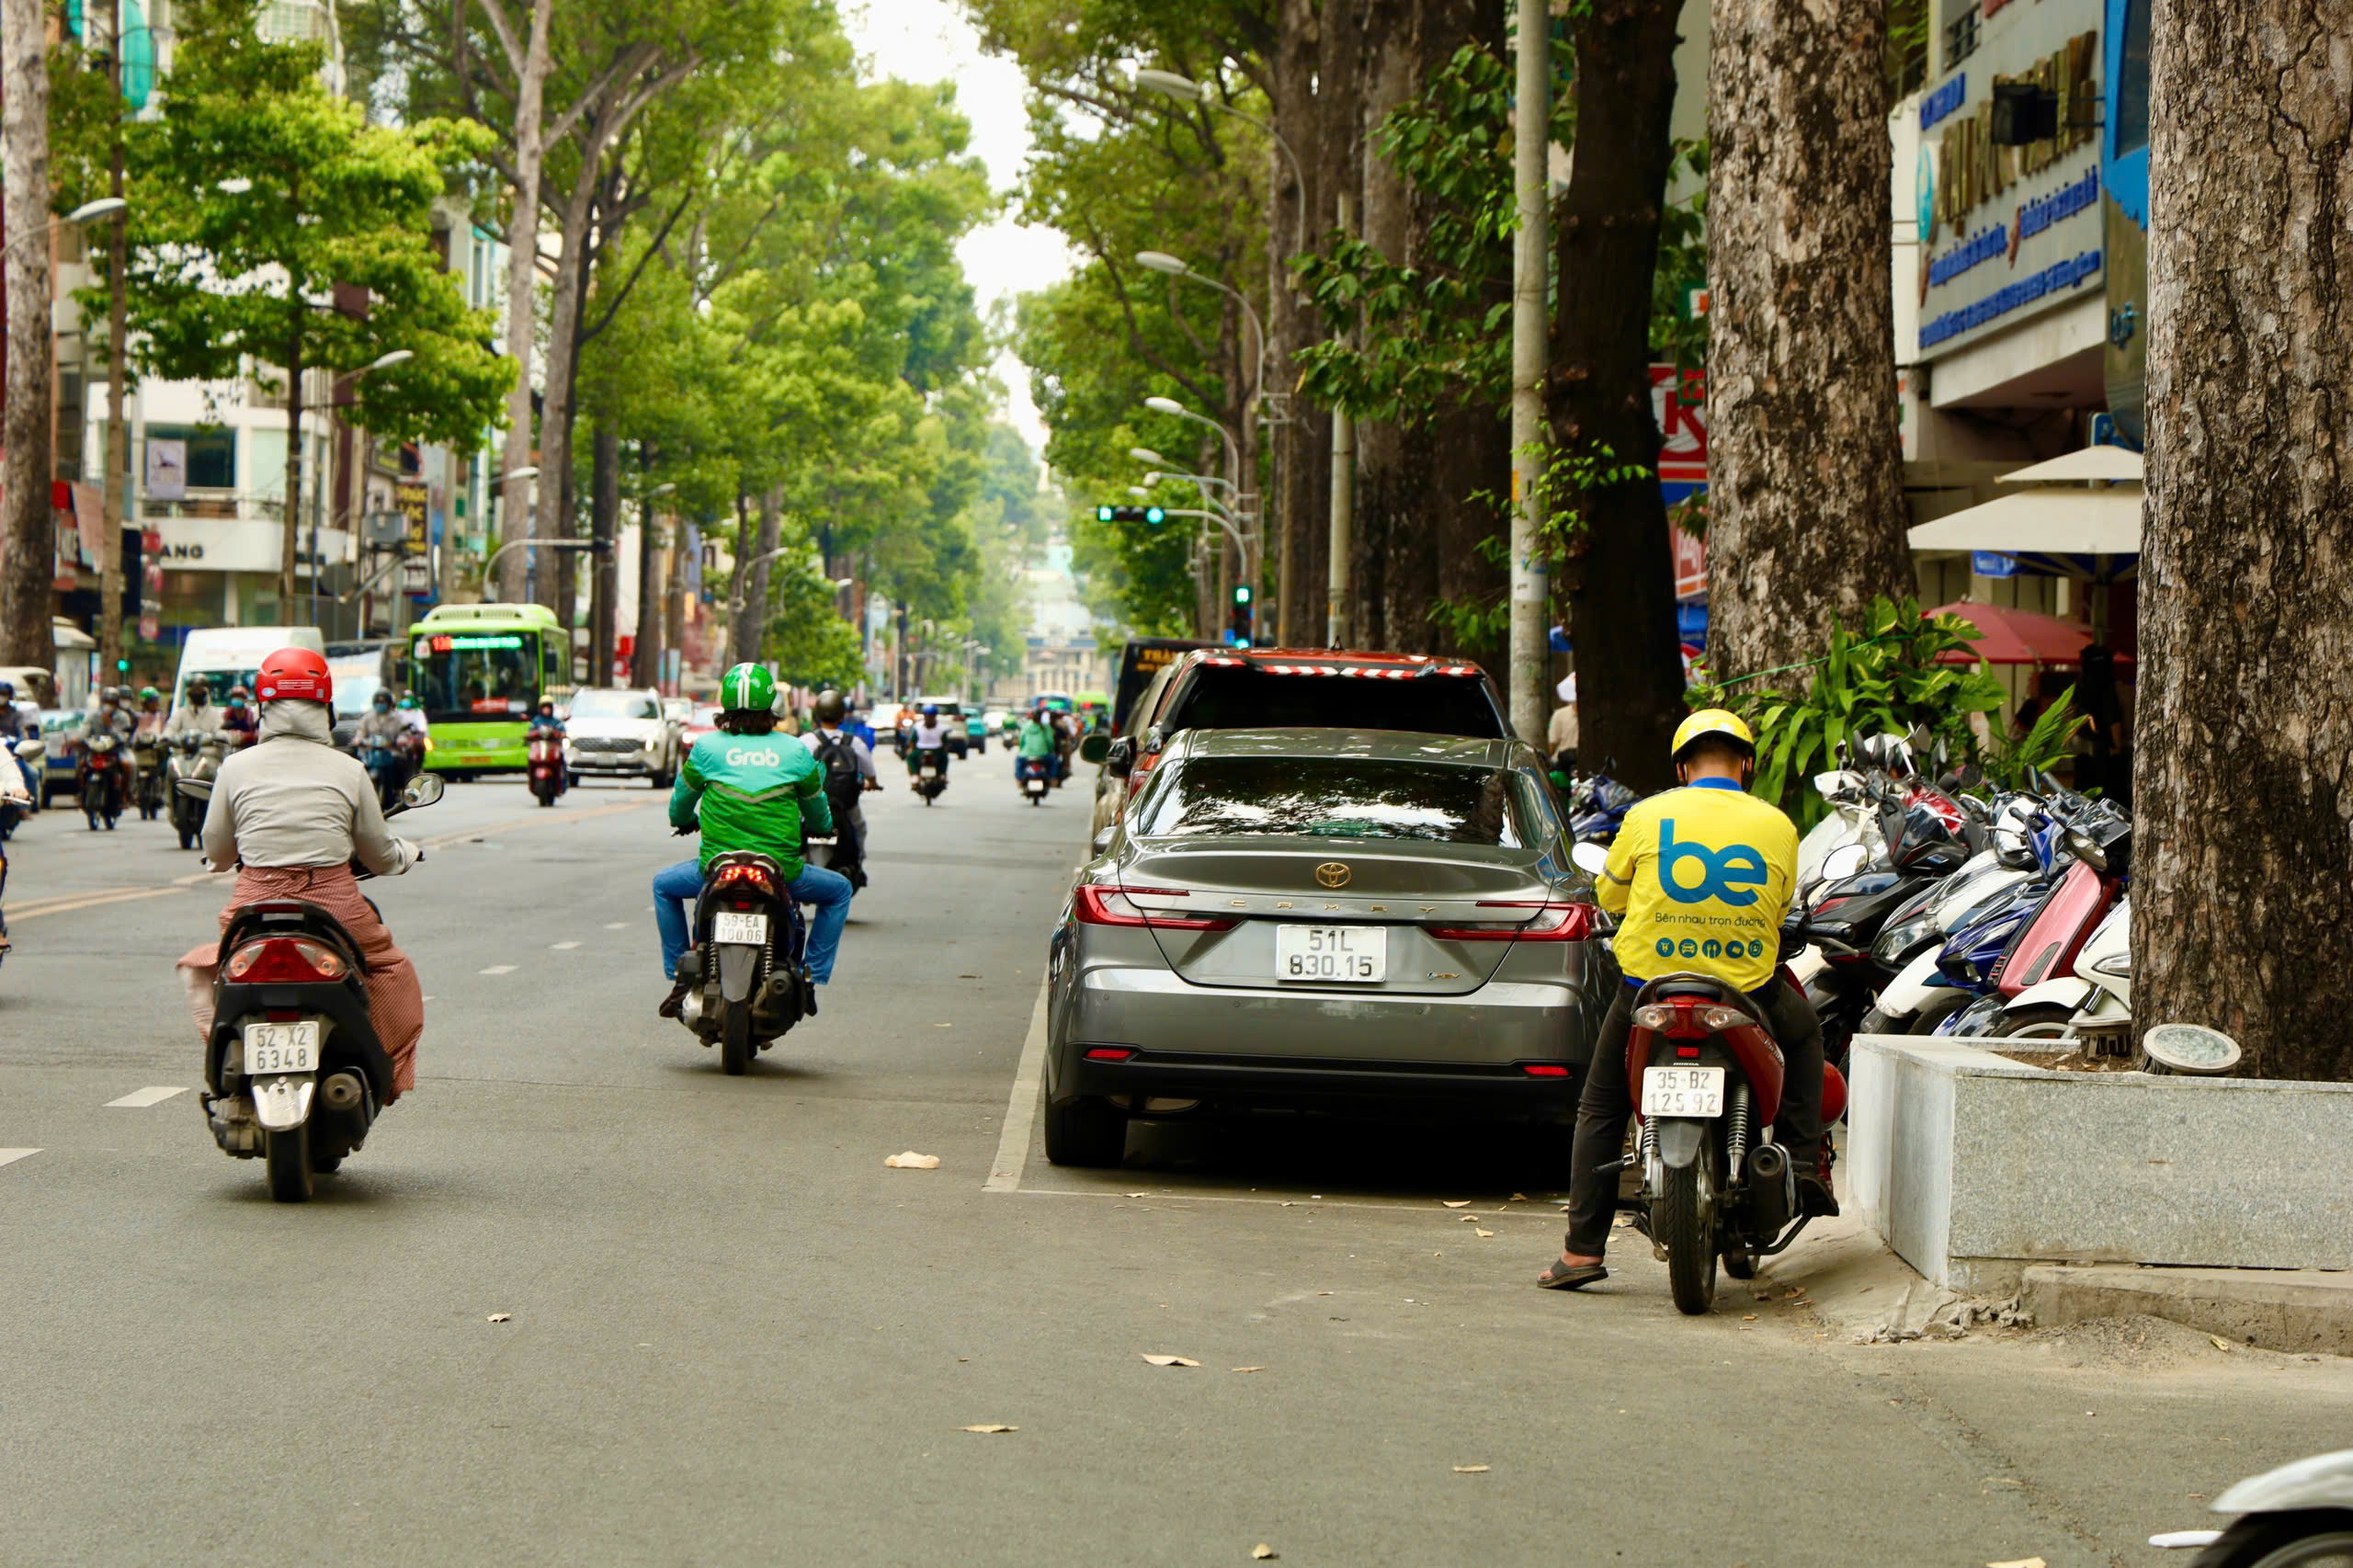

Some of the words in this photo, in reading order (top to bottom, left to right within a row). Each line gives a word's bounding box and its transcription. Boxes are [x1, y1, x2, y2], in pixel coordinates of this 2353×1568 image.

[726, 746, 779, 767] Grab
[1658, 819, 1768, 906] be
[1230, 900, 1437, 913] CAMRY
[1655, 913, 1676, 923] Bên
[1678, 914, 1706, 925] nhau
[1710, 916, 1732, 927] trọn
[1309, 930, 1354, 952] 51L
[1289, 955, 1373, 977] 830.15
[257, 1049, 307, 1070] 6348
